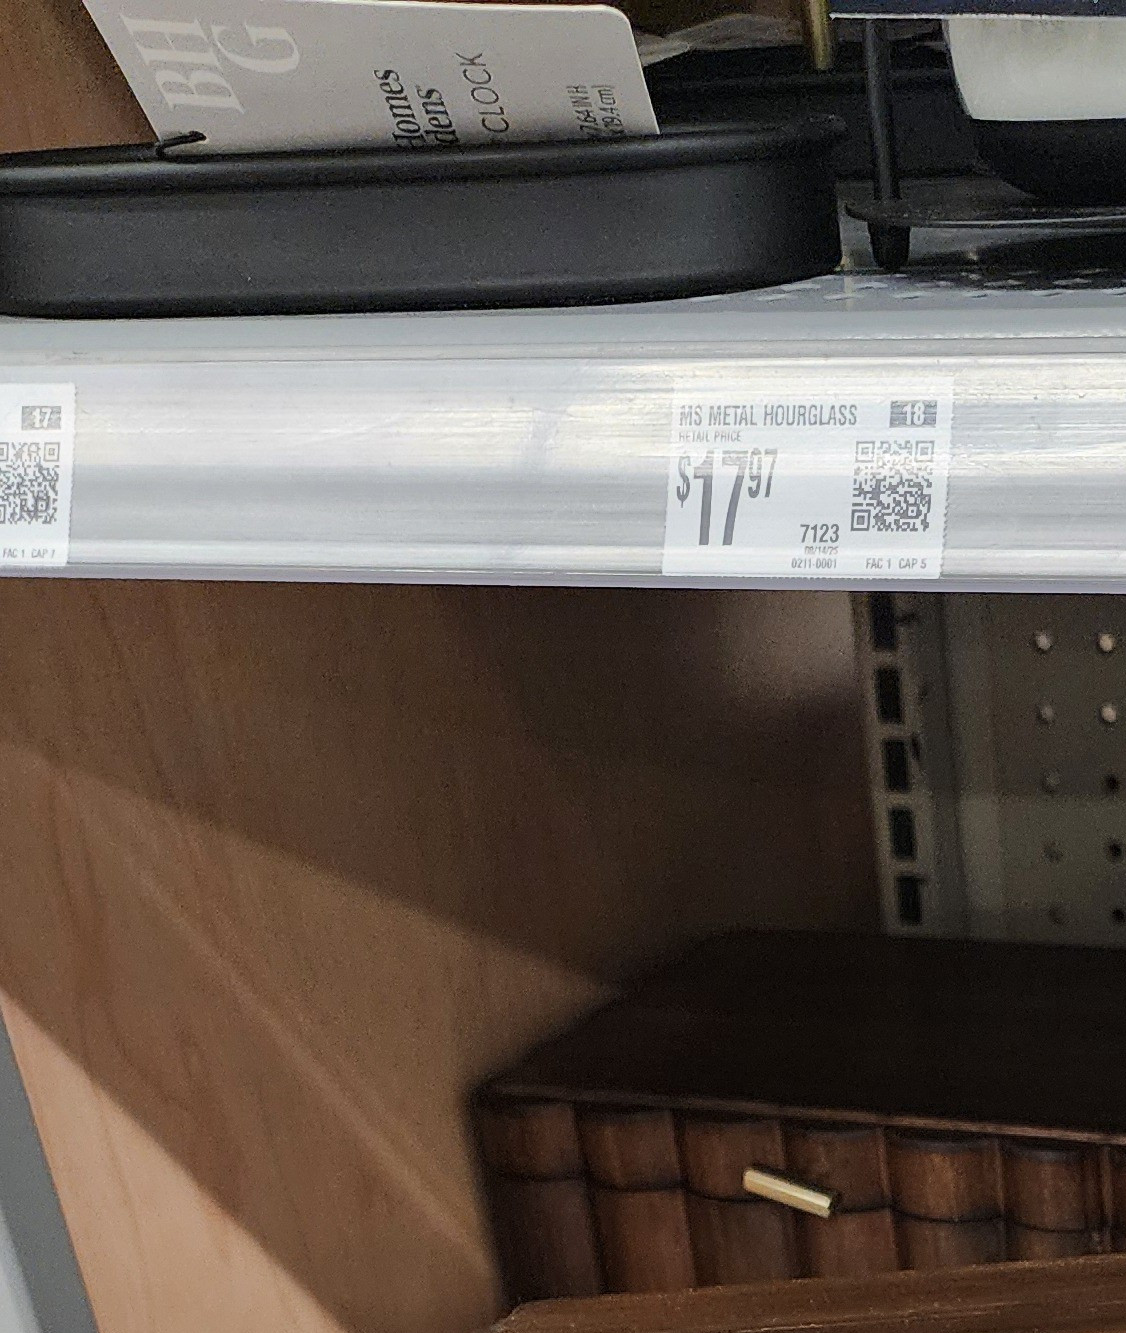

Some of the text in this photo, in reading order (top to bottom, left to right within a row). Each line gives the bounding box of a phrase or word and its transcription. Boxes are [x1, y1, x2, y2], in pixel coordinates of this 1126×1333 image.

[210, 19, 300, 74] G
[119, 12, 246, 115] BH
[456, 52, 510, 133] CLOCK
[415, 84, 459, 144] dens
[31, 407, 52, 428] 17
[679, 404, 858, 427] MS METAL HOURGLASS
[903, 402, 926, 426] 18
[678, 431, 742, 443] RETAIL PRICE
[800, 523, 840, 543] 7123
[865, 557, 928, 570] FAC 1 CAP 5
